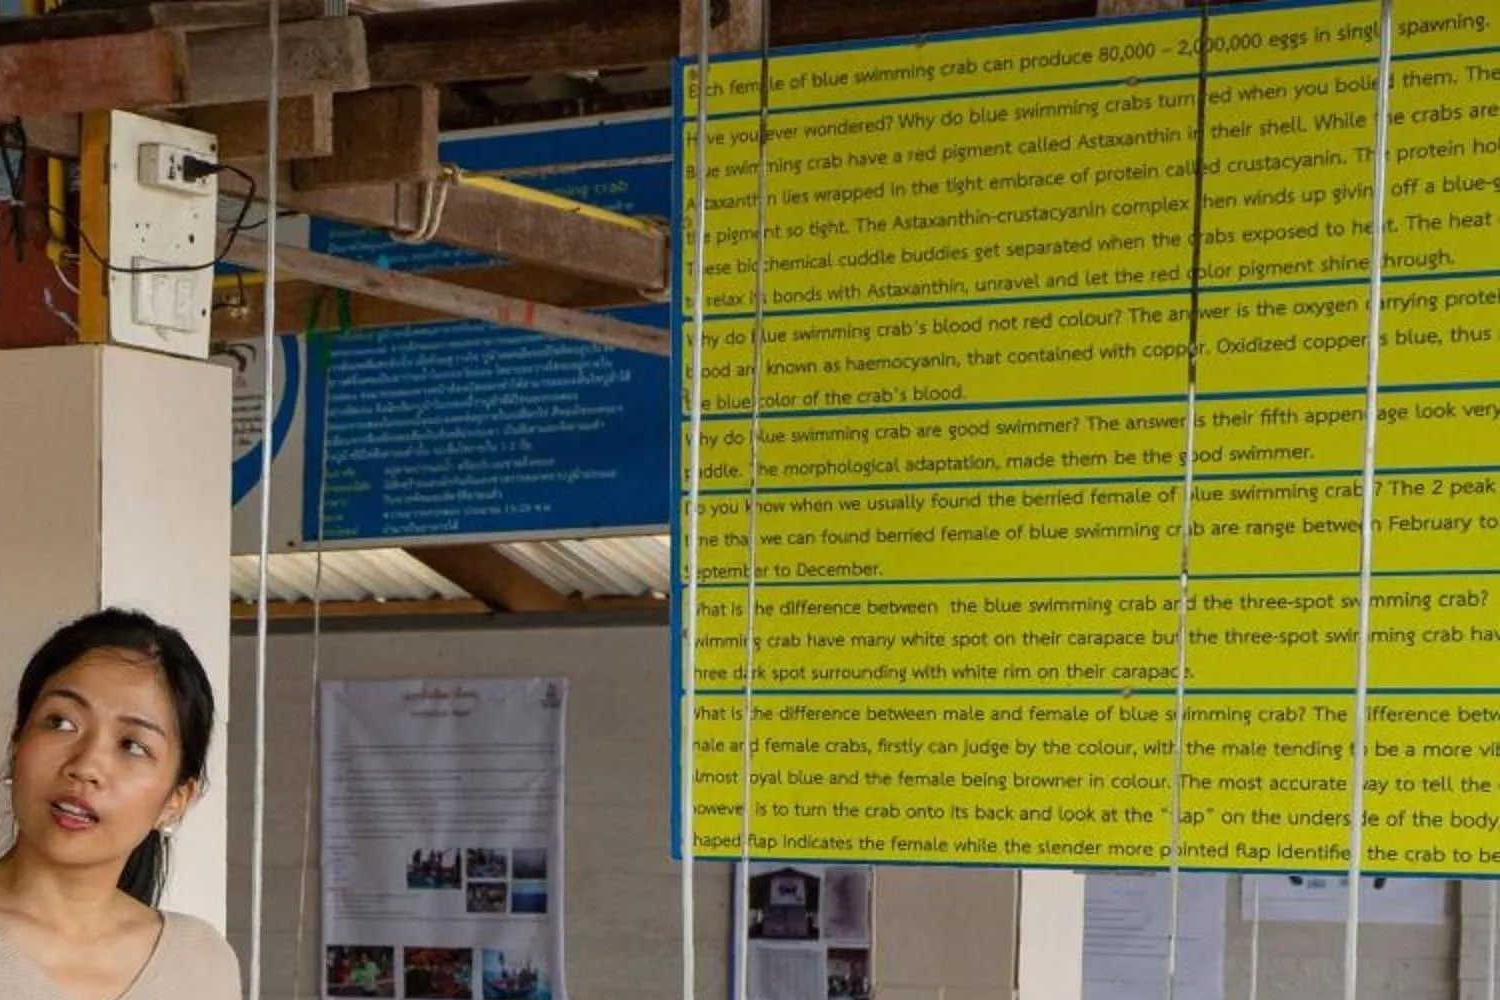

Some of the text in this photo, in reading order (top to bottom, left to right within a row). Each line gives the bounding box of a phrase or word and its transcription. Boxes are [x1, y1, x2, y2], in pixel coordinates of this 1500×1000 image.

[811, 13, 1489, 87] blue swimming crab produce 80,000 eggs spawning.
[803, 114, 893, 137] wondered?
[897, 112, 935, 129] Why
[969, 107, 1008, 124] blue
[1015, 99, 1098, 120] swimming
[1105, 95, 1151, 112] crabs
[1158, 94, 1194, 108] turn
[1237, 85, 1286, 100] when
[1294, 83, 1328, 99] you
[807, 153, 842, 170] crab
[847, 153, 887, 165] have
[908, 146, 935, 161] red
[942, 141, 1011, 162] pigment
[1018, 135, 1070, 154] called
[1077, 127, 1180, 148] Astaxanthin
[1210, 121, 1251, 138] their
[1314, 112, 1366, 130] While
[1411, 104, 1462, 123] crabs
[783, 140, 1464, 204] lies wrapped tight embrace protein crustacyanin. protein
[809, 220, 848, 238] tight.
[1111, 196, 1188, 216] complex
[1243, 187, 1294, 205] winds
[838, 211, 1491, 266] cuddle buddies get separated when exposed heat
[773, 287, 821, 303] bonds
[827, 284, 860, 300] with
[975, 274, 1039, 291] unravel
[1151, 265, 1179, 281] red
[1238, 259, 1313, 280] pigment
[792, 299, 1357, 341] swimming crab's blood red colour? oxygen
[766, 359, 817, 374] known
[966, 351, 1000, 365] that
[1007, 344, 1093, 363] contained
[1099, 343, 1136, 359] with
[1216, 335, 1296, 354] Oxidized
[1450, 326, 1490, 342] thus
[857, 387, 906, 407] crab's
[791, 401, 1455, 443] swimming crab good swimmer? answer their fifth look
[783, 458, 899, 477] morphological
[1006, 451, 1054, 468] made
[1061, 451, 1107, 466] them
[1229, 445, 1313, 461] swimmer.
[710, 478, 1495, 517] you usually found berried female swimming peak
[821, 514, 1472, 544] found berried female blue swimming range February
[796, 562, 881, 580] December.
[779, 589, 1488, 615] difference between blue swimming crab three-spot crab?
[767, 626, 1462, 649] crab have many white spot their carapace three-spot crab
[771, 663, 1105, 683] spot surrounding with white rim their
[779, 705, 1305, 722] difference between male female blue crab?
[764, 737, 819, 752] female
[877, 737, 922, 756] firstly
[962, 740, 1009, 757] judge
[1222, 740, 1266, 755] male
[1273, 740, 1342, 760] tending
[1423, 745, 1472, 757] more
[787, 770, 823, 784] blue
[897, 770, 954, 786] female
[961, 771, 1006, 790] being
[1013, 771, 1082, 788] browner
[1218, 776, 1261, 790] most
[1269, 777, 1346, 790] accurate
[1421, 775, 1452, 792] tell
[793, 803, 1095, 822] turn crab onto back look
[783, 834, 1445, 862] indicates female while slender more flap crab
